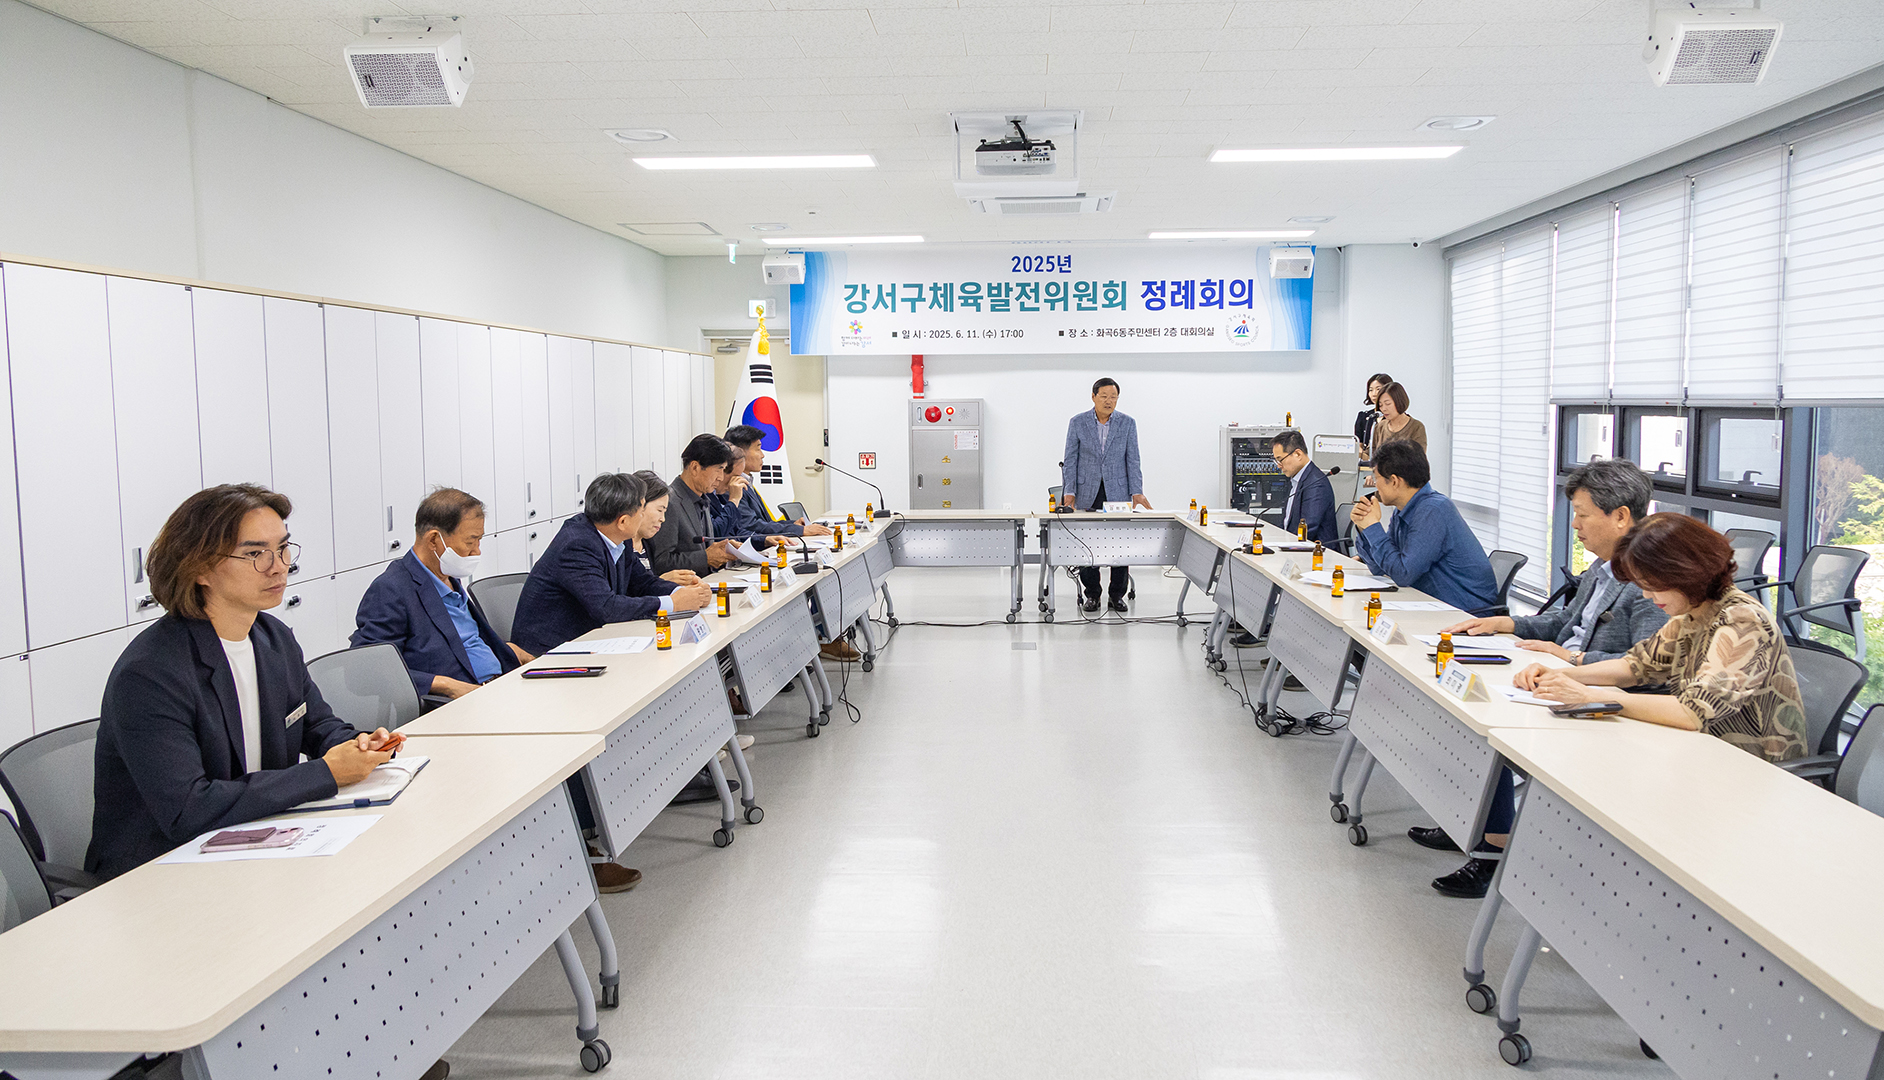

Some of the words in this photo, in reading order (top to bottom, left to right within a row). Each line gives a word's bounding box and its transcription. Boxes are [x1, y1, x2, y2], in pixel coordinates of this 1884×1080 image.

[1011, 255, 1072, 274] 2025년
[843, 280, 1127, 314] 강서구체육발전위원회
[1140, 279, 1254, 311] 정례회의
[901, 329, 910, 339] 일
[912, 329, 922, 339] 시
[929, 329, 954, 339] 2025.
[955, 329, 964, 339] 6.
[966, 329, 980, 339] 11.
[982, 329, 997, 340] (수)
[1000, 329, 1024, 339] 17:00
[1068, 328, 1078, 339] 장
[1079, 329, 1089, 338] 소
[1096, 327, 1161, 338] 화곡6동주민센터
[1163, 327, 1178, 337] 2층
[1180, 327, 1215, 337] 대회의실
